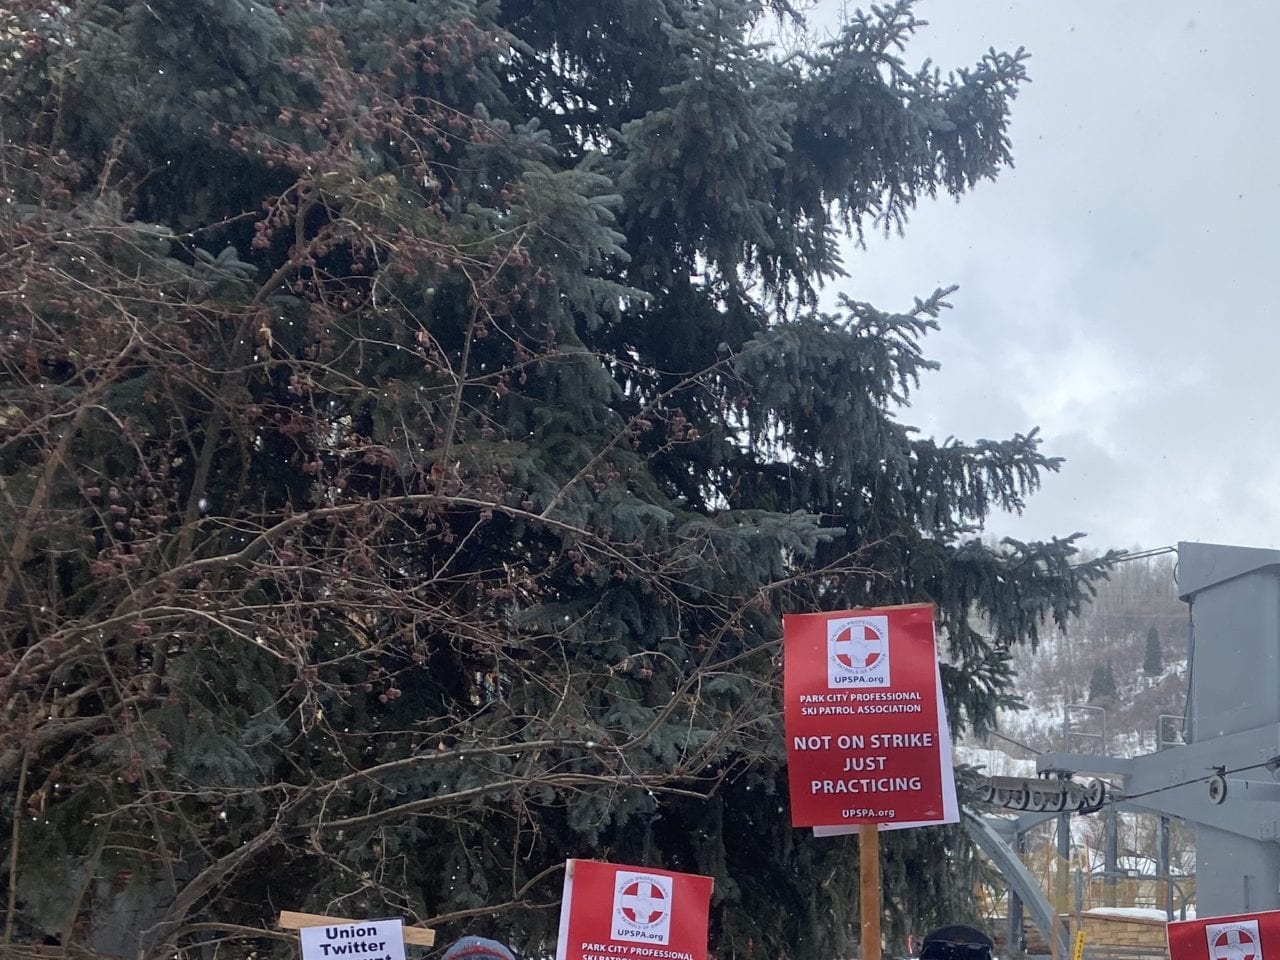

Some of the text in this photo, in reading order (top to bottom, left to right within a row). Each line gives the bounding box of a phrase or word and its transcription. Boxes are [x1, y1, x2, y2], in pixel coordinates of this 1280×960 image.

[834, 676, 884, 684] UPSPA.org
[800, 692, 922, 703] PARK CITY PROFESSIONAL
[801, 704, 921, 715] SKI PATROL ASSOCIATION
[793, 733, 933, 750] NOT ON STRIKE
[843, 756, 887, 771] JUST
[811, 777, 922, 794] PRACTICING
[842, 808, 895, 818] UPSPA.org
[325, 926, 377, 939] Union
[617, 929, 664, 942] UPSPA.org
[320, 941, 386, 956] Twitter
[581, 942, 694, 960] PARK CITY PROFESSIONAL
